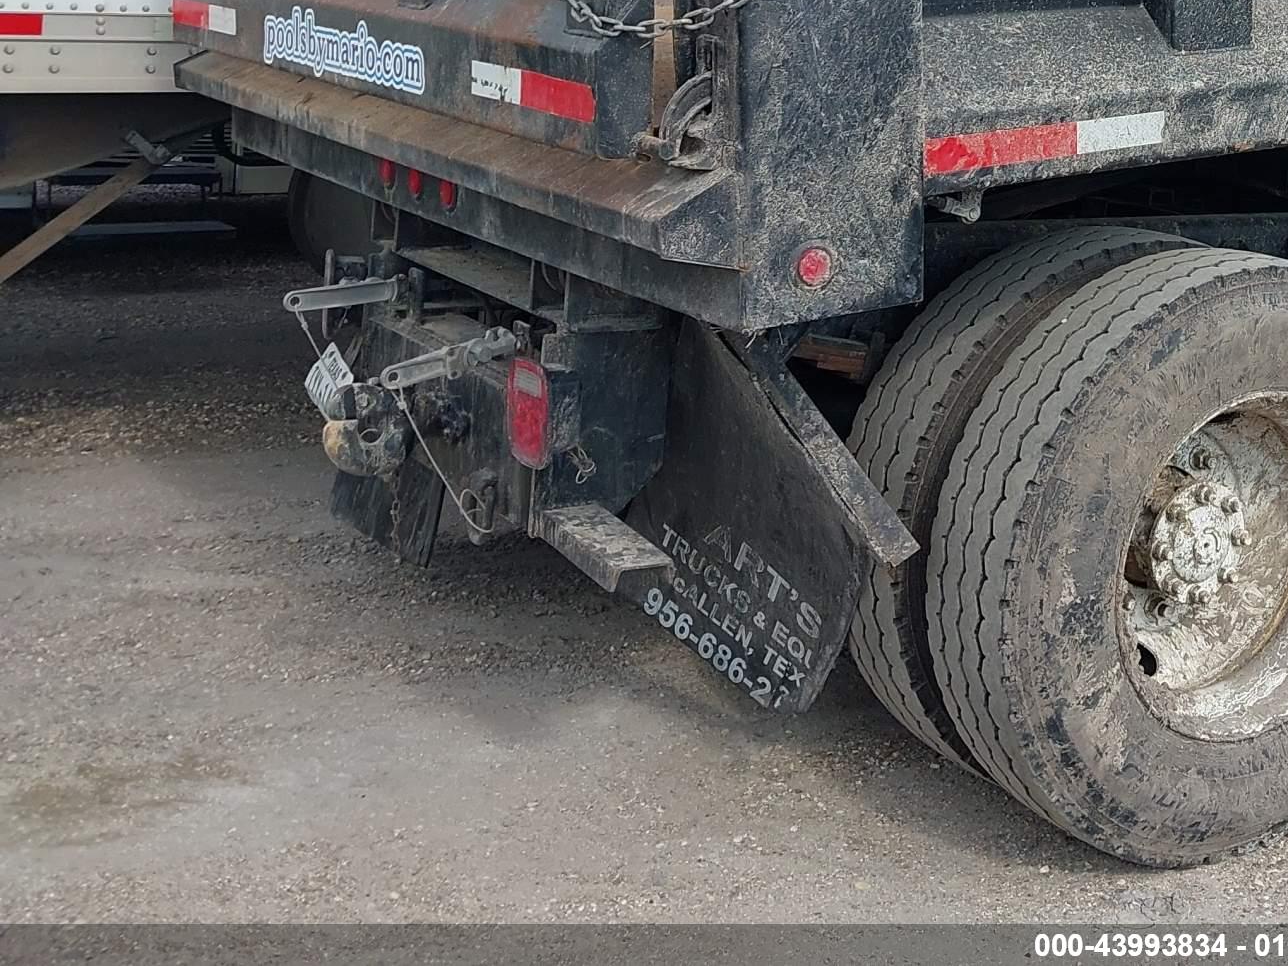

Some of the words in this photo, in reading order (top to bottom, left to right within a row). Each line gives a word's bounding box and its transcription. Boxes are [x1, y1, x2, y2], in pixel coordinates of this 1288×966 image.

[265, 8, 423, 89] poolsbymario.com
[662, 523, 751, 613] TRUCKS
[753, 611, 767, 630] &
[673, 577, 754, 656] cALLEN,
[703, 524, 822, 639] ART'S
